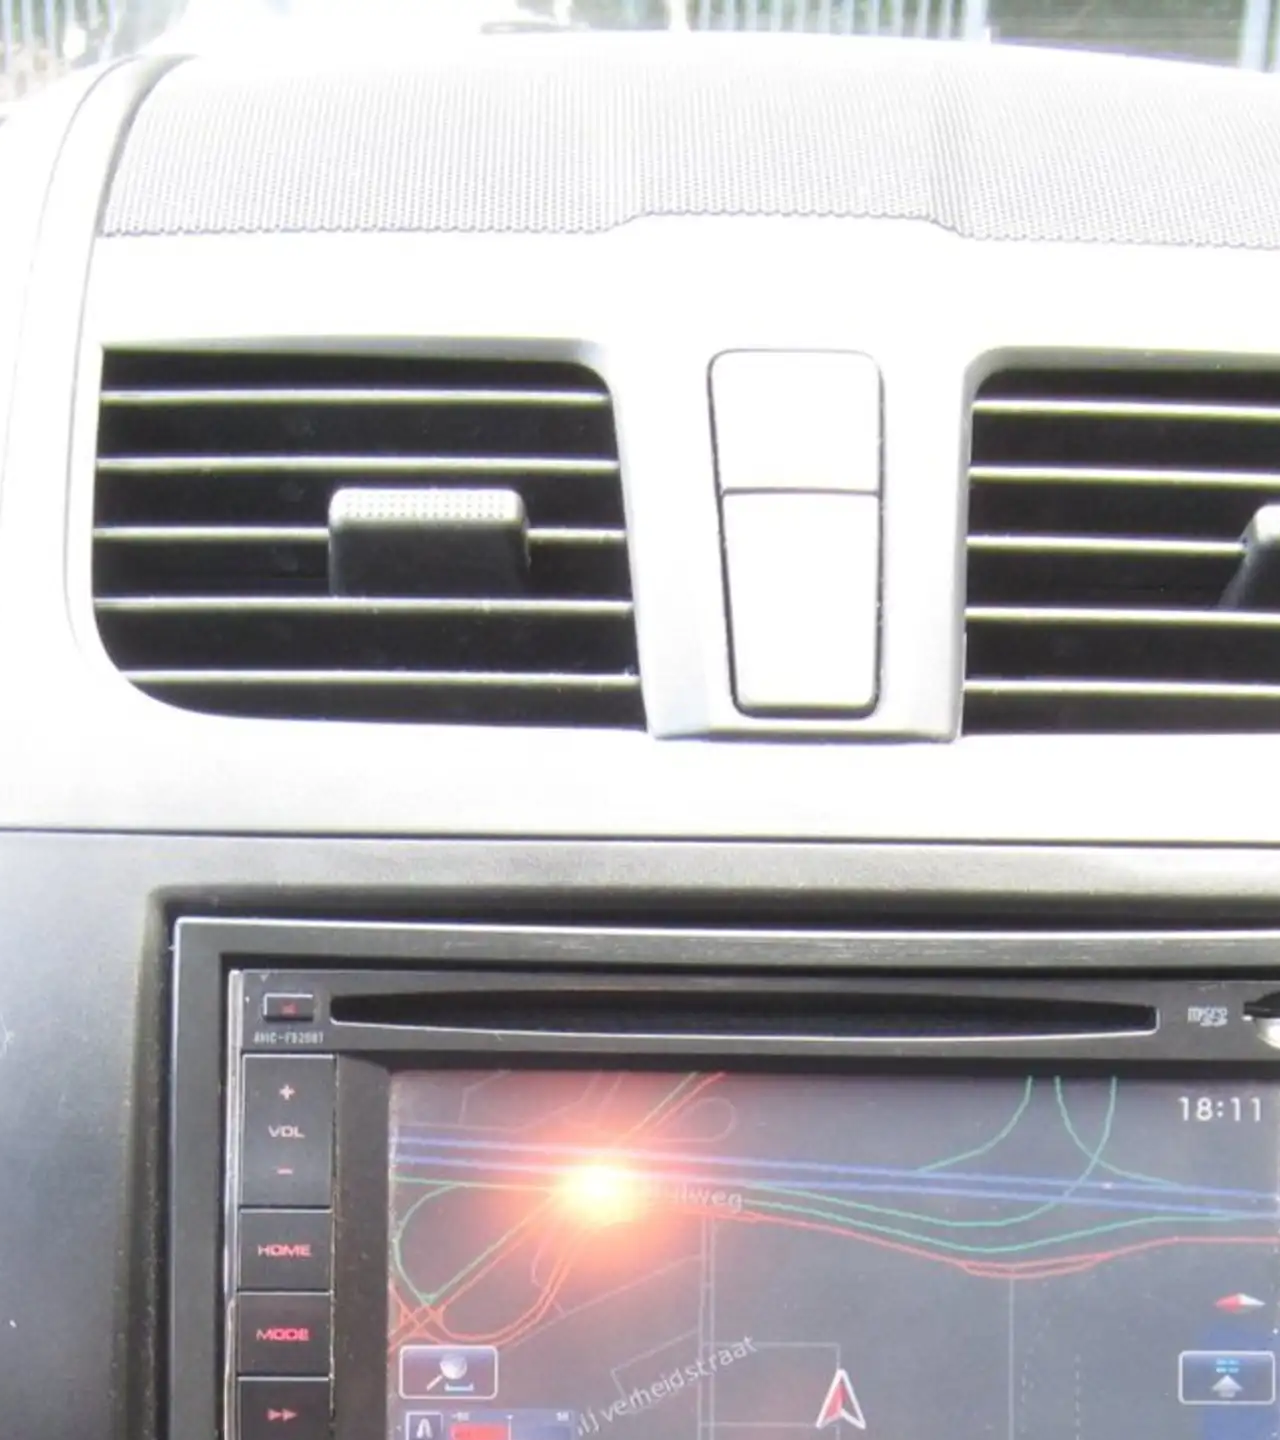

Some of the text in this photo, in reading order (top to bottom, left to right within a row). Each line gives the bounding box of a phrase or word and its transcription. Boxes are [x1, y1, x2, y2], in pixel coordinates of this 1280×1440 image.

[1178, 1097, 1262, 1122] 18:11
[268, 1125, 305, 1138] VOL
[257, 1244, 311, 1257] HOME
[256, 1328, 310, 1341] MODE
